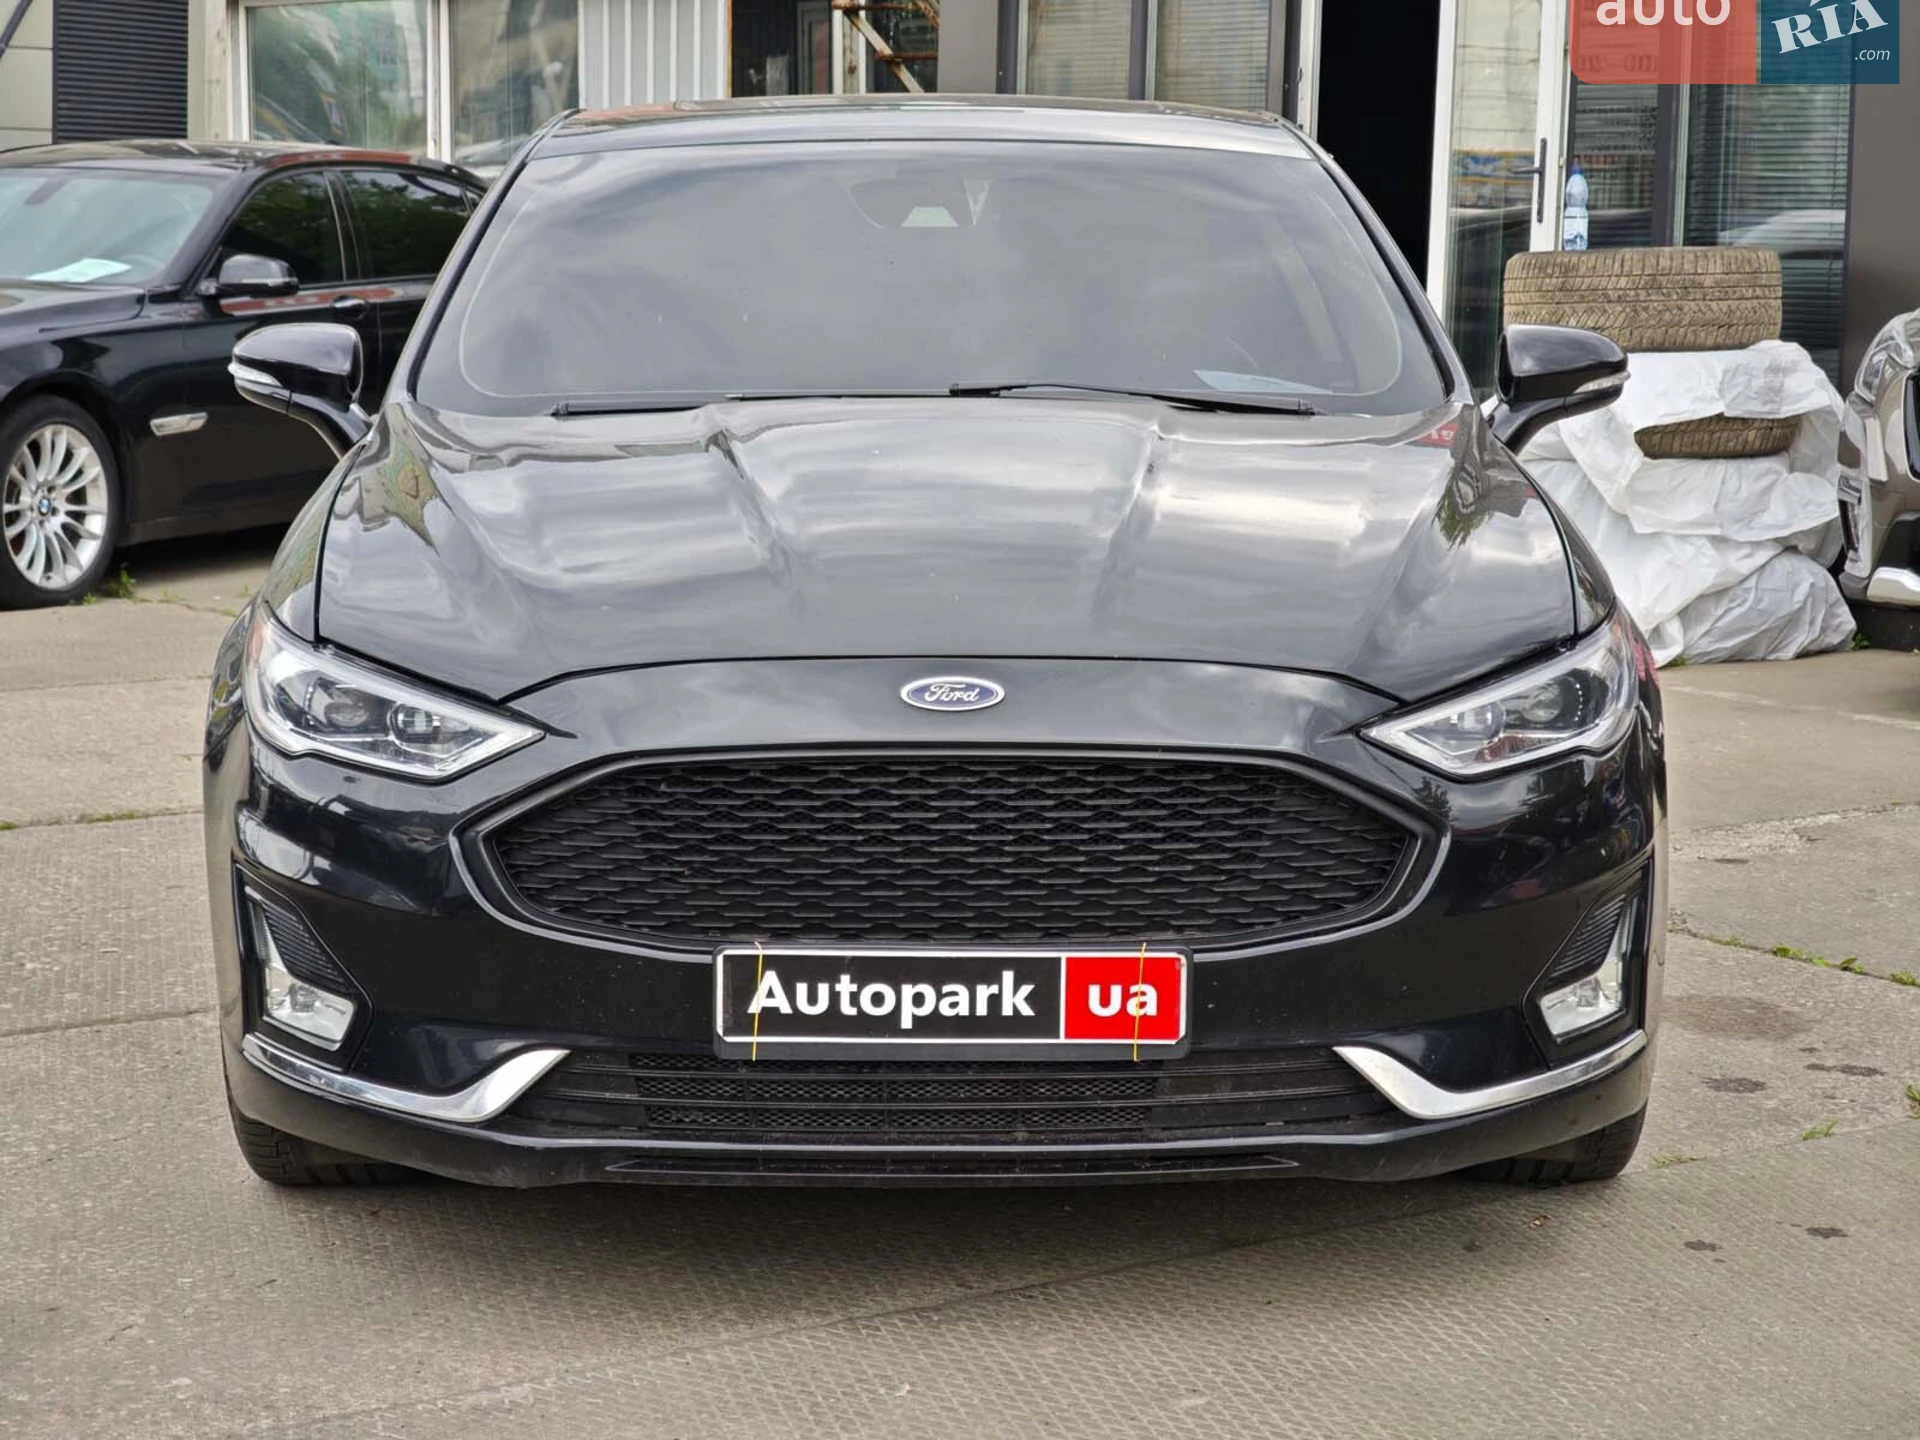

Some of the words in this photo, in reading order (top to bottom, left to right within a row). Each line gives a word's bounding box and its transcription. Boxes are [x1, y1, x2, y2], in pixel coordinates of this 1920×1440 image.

[924, 683, 980, 702] Ford
[747, 969, 1036, 1029] Autopark
[1087, 983, 1159, 1017] ua
